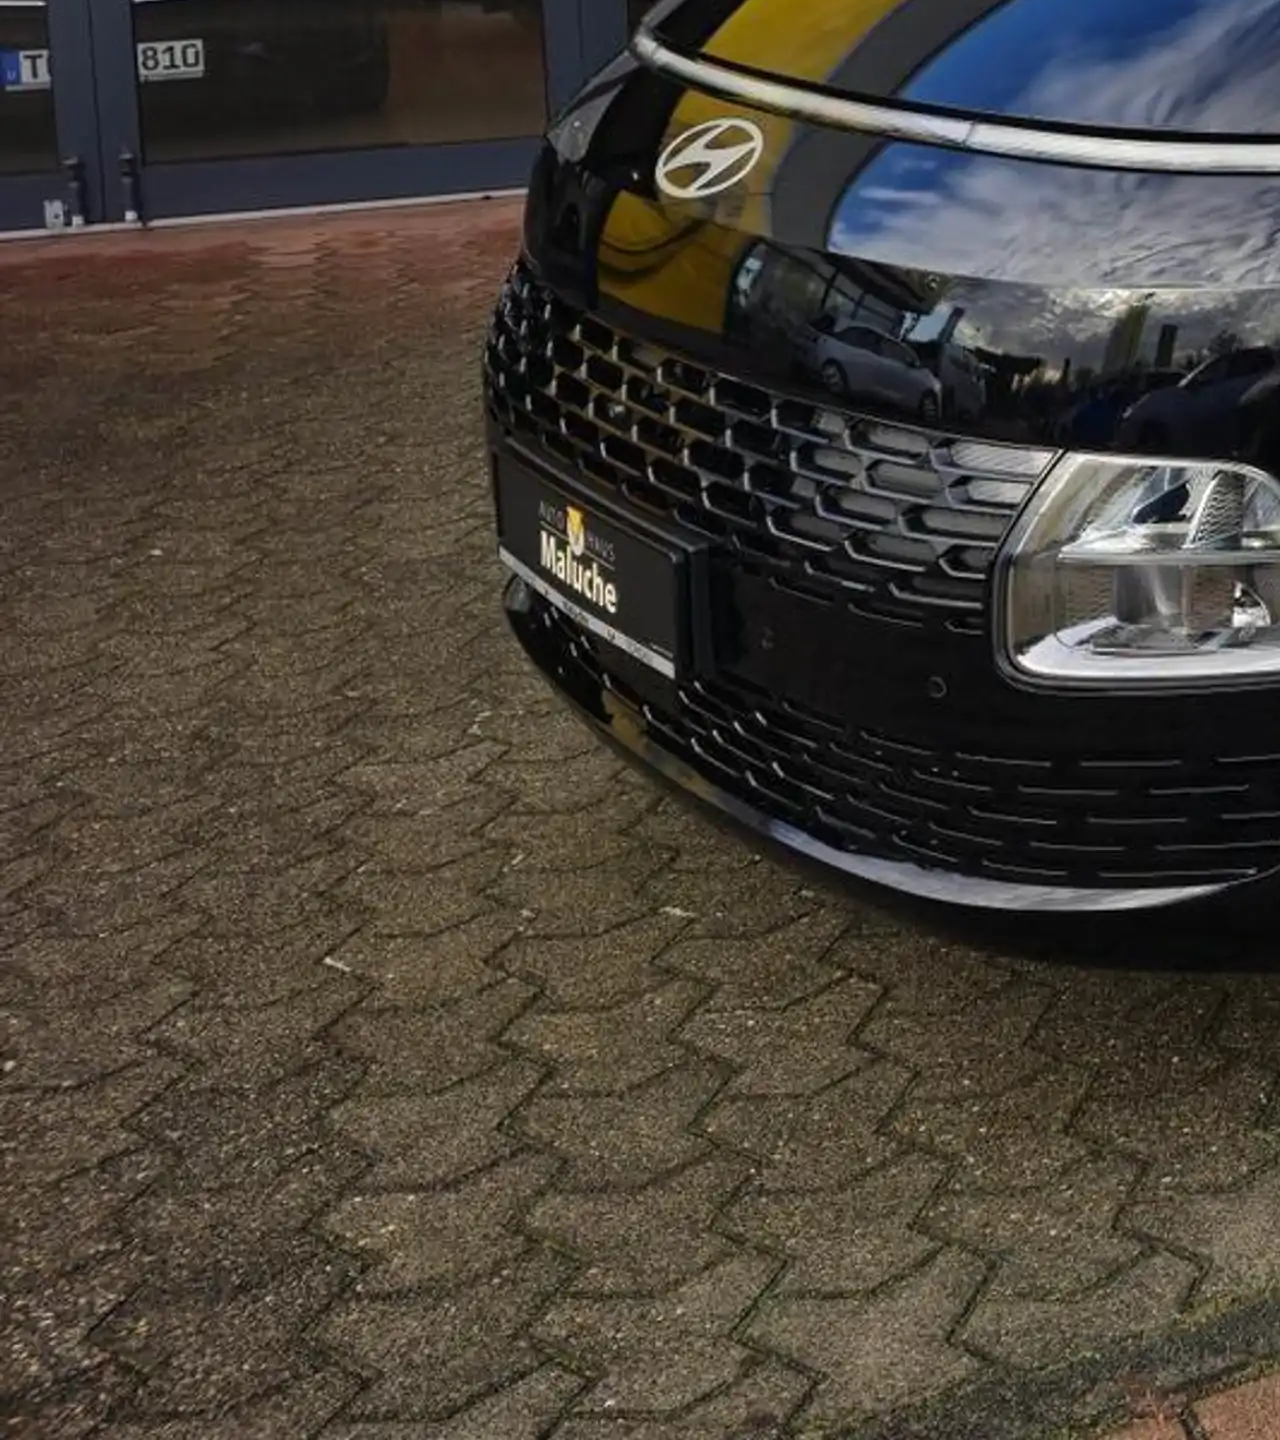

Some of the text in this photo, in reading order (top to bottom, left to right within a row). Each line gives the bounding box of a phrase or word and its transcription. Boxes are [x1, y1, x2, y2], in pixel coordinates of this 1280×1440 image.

[22, 52, 51, 79] T
[141, 43, 200, 70] 810
[540, 530, 618, 613] Maluche
